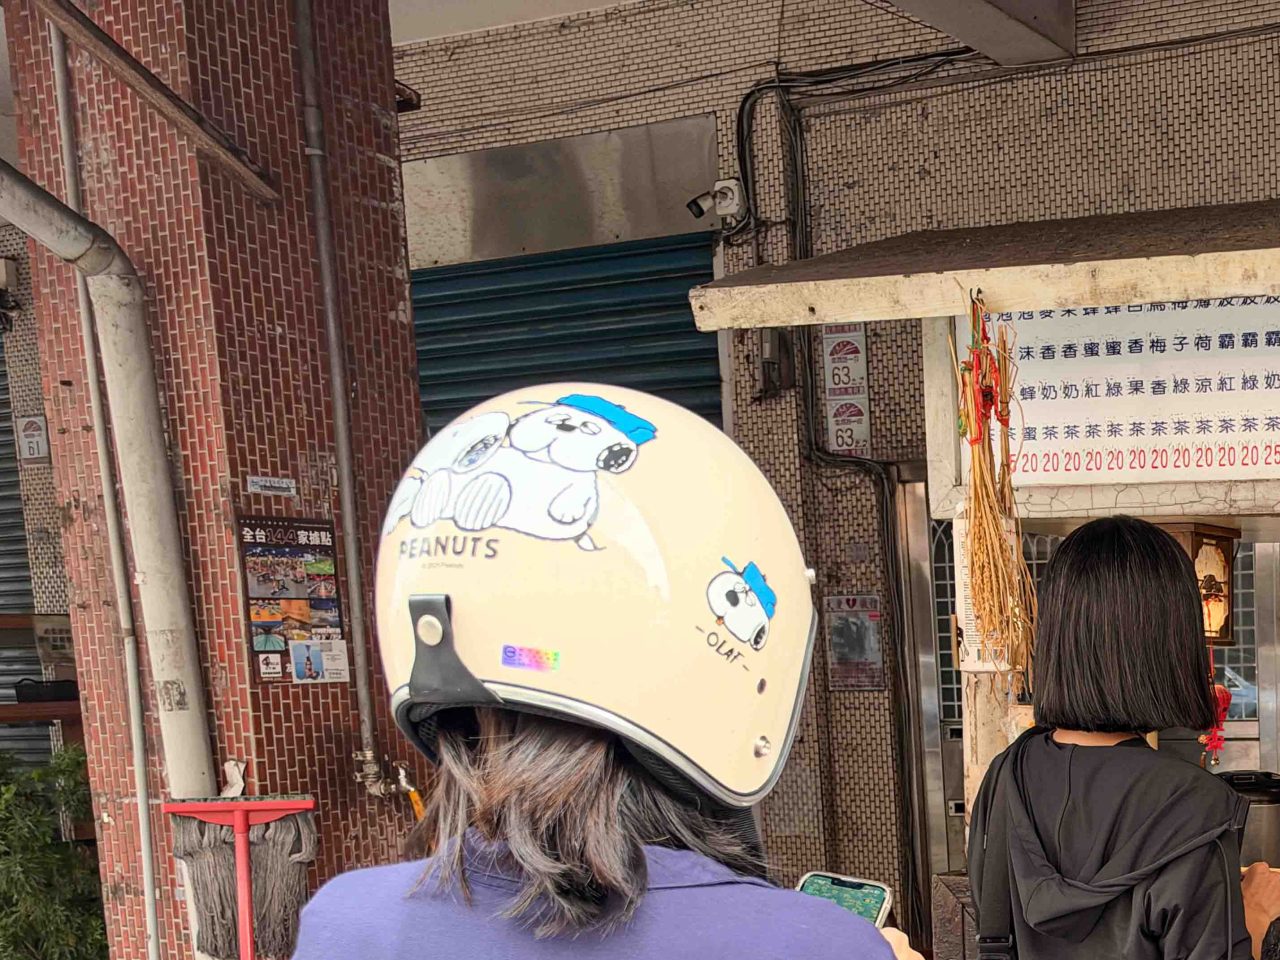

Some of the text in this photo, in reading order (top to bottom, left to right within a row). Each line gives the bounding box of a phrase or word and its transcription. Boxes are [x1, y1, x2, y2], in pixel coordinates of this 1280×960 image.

[832, 366, 851, 386] 63
[835, 428, 854, 448] 63
[1022, 454, 1037, 472] 20
[1043, 453, 1059, 472] 20
[1064, 452, 1080, 471] 20
[1085, 452, 1101, 471] 20
[1108, 451, 1123, 470] 20
[1129, 450, 1145, 469] 20
[1152, 449, 1168, 469] 20
[1174, 448, 1190, 468] 20
[1196, 448, 1212, 467] 20
[1218, 447, 1236, 466] 20
[1241, 446, 1258, 466] 20
[400, 535, 499, 559] PEANUTS
